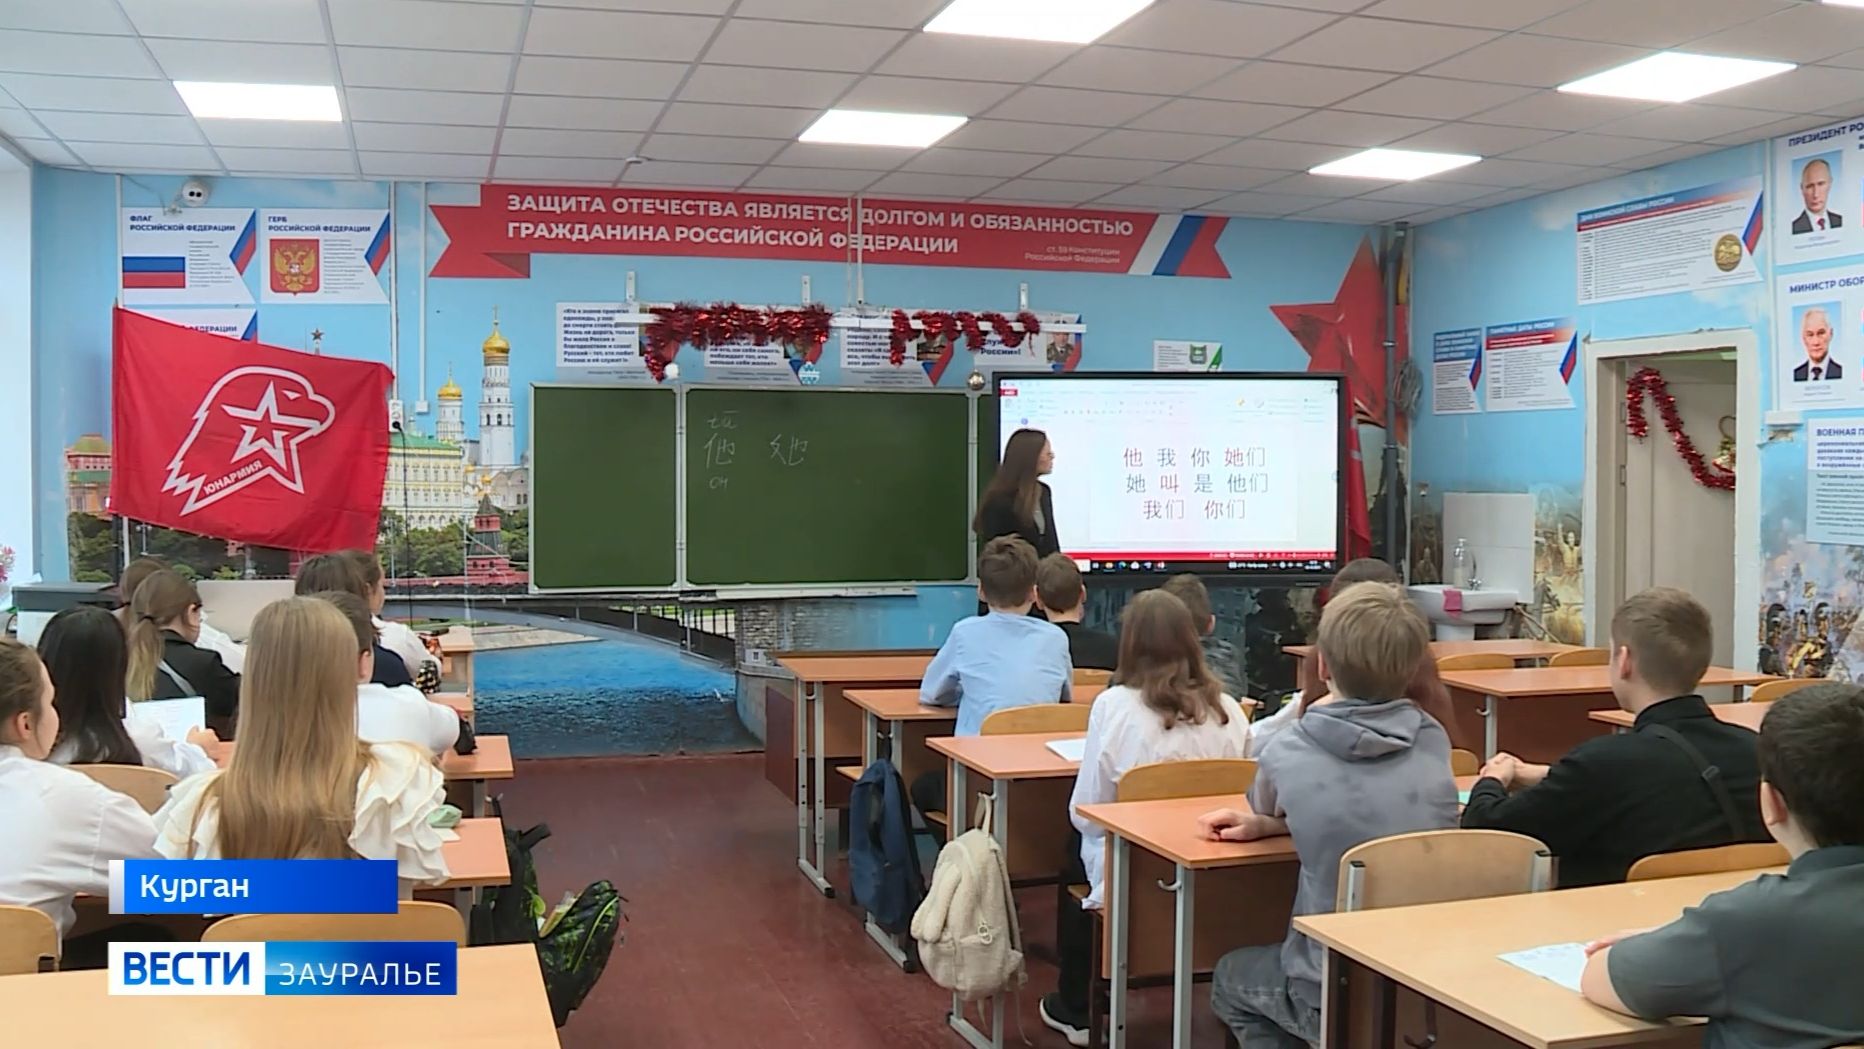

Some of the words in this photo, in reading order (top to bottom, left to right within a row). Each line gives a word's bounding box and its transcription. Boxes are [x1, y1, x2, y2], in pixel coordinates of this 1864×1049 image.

[1788, 126, 1847, 147] ПРЕЗИДЕНТ
[507, 194, 606, 214] ЗАЩИТА
[612, 197, 738, 218] ОТЕЧЕСТВА
[744, 201, 851, 222] ЯВЛЯЕТСЯ
[861, 206, 945, 227] ДОЛГОМ
[951, 213, 965, 227] И
[970, 214, 1134, 236] ОБЯЗАННОСТЬЮ
[130, 223, 185, 232] РОССИЙСКОЙ
[186, 224, 236, 233] ФЕДЕРАЦИИ
[268, 223, 321, 232] РОССИЙСКОЙ
[322, 225, 371, 233] ФЕДЕРАЦИИ
[507, 222, 671, 243] ГРАЖДАНИНА
[675, 224, 824, 247] РОССИЙСКОЙ
[829, 231, 959, 255] ФЕДЕРАЦИИ
[1024, 252, 1073, 262] Российской
[1074, 254, 1121, 264] Федерации
[1789, 280, 1836, 294] МИНИСТР
[191, 325, 237, 334] ЕДЕРАЦИИ
[1817, 428, 1857, 436] ВОЕННАЯ
[704, 432, 735, 468] 他
[1123, 447, 1143, 468] 他
[1157, 447, 1176, 468] 我
[1191, 447, 1210, 468] 你
[1224, 446, 1266, 468] 她们
[203, 459, 263, 495] ЮНАРМИЯ
[1126, 473, 1146, 493] 她
[1160, 473, 1179, 493] 叫
[1194, 473, 1213, 493] 是
[1227, 472, 1269, 493] 他们
[1143, 499, 1184, 520] 我们
[1204, 499, 1246, 520] 你们
